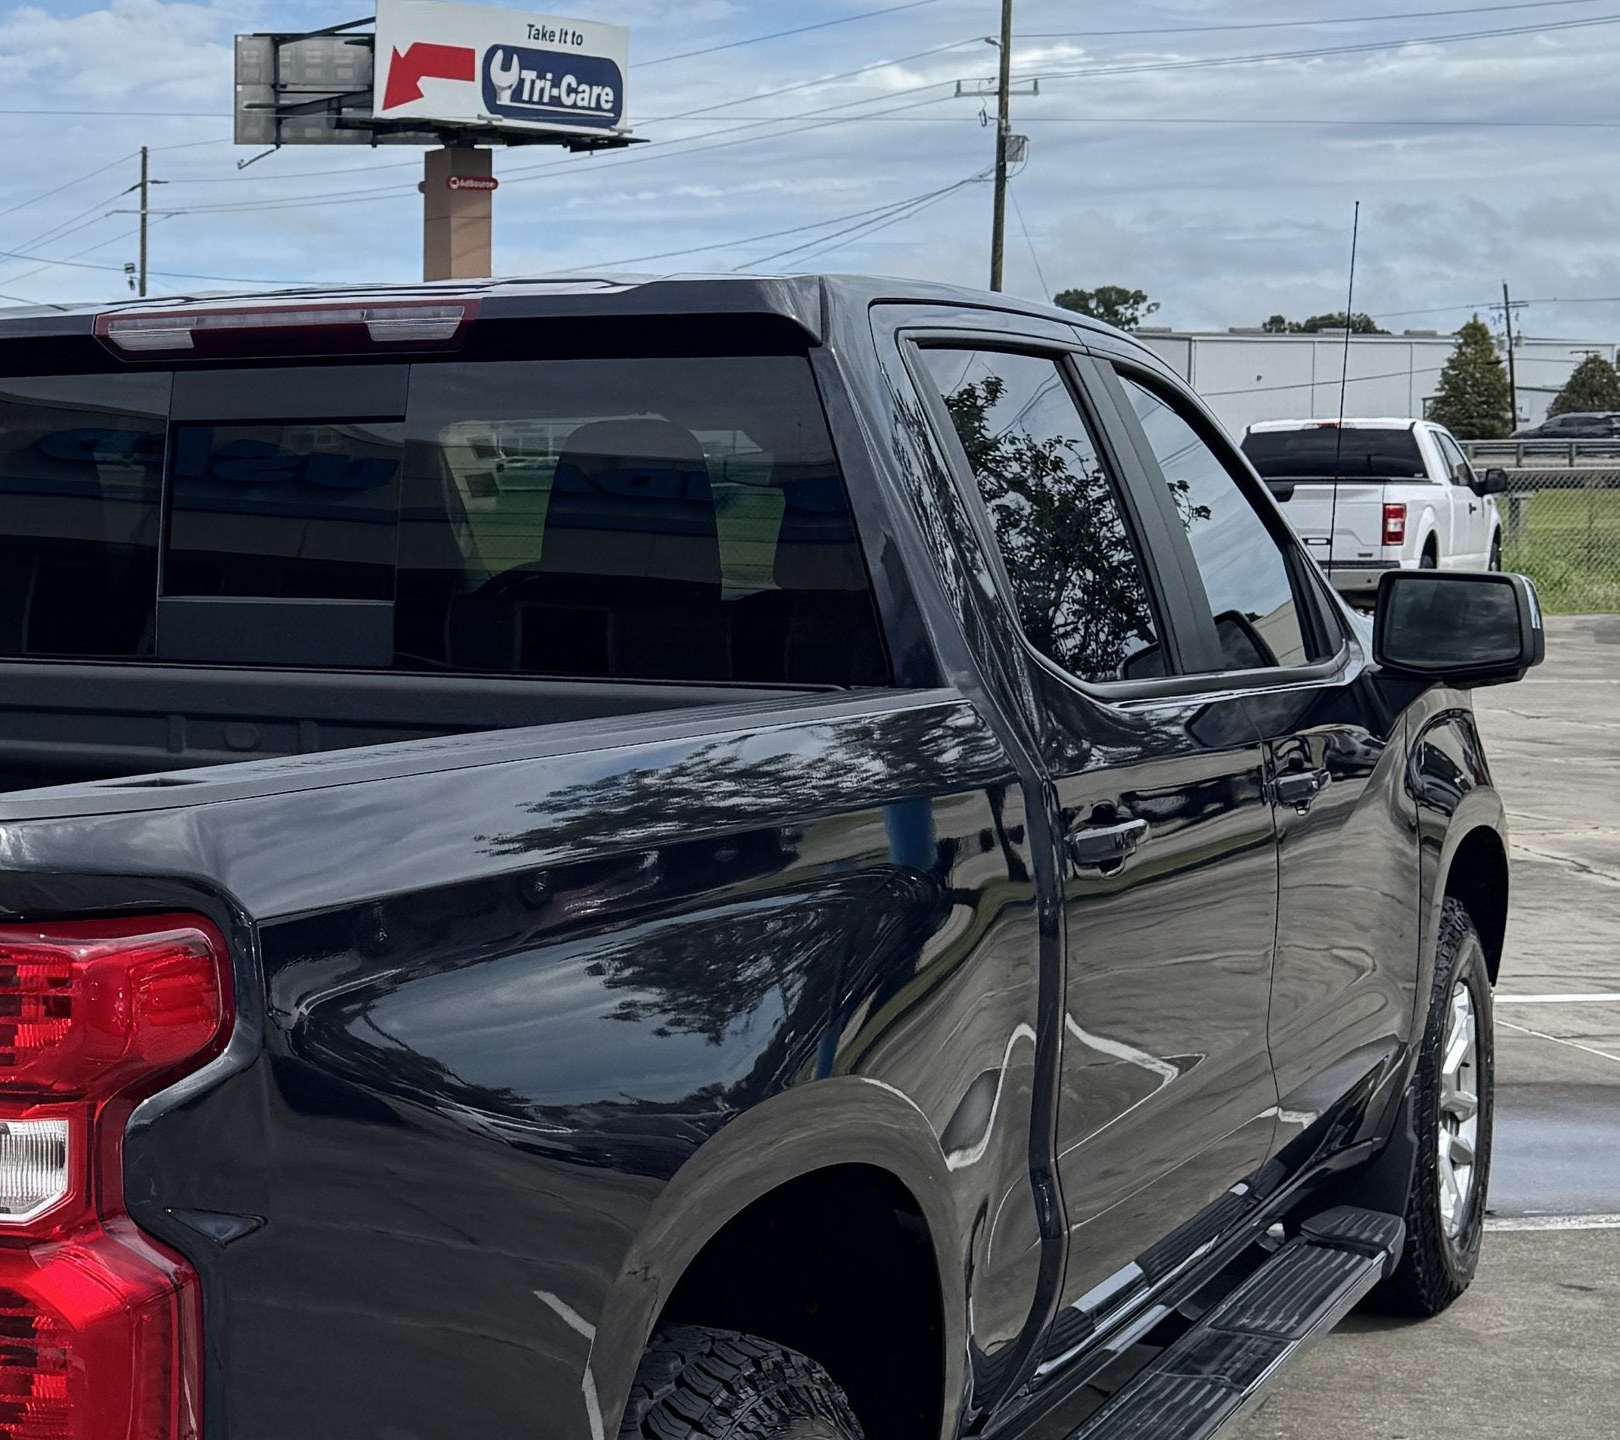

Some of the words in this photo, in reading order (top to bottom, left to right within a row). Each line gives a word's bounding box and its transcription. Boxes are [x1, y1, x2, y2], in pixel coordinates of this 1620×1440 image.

[527, 24, 556, 43] Take
[559, 27, 569, 45] It
[571, 31, 584, 46] to
[521, 70, 614, 110] Tri-Care
